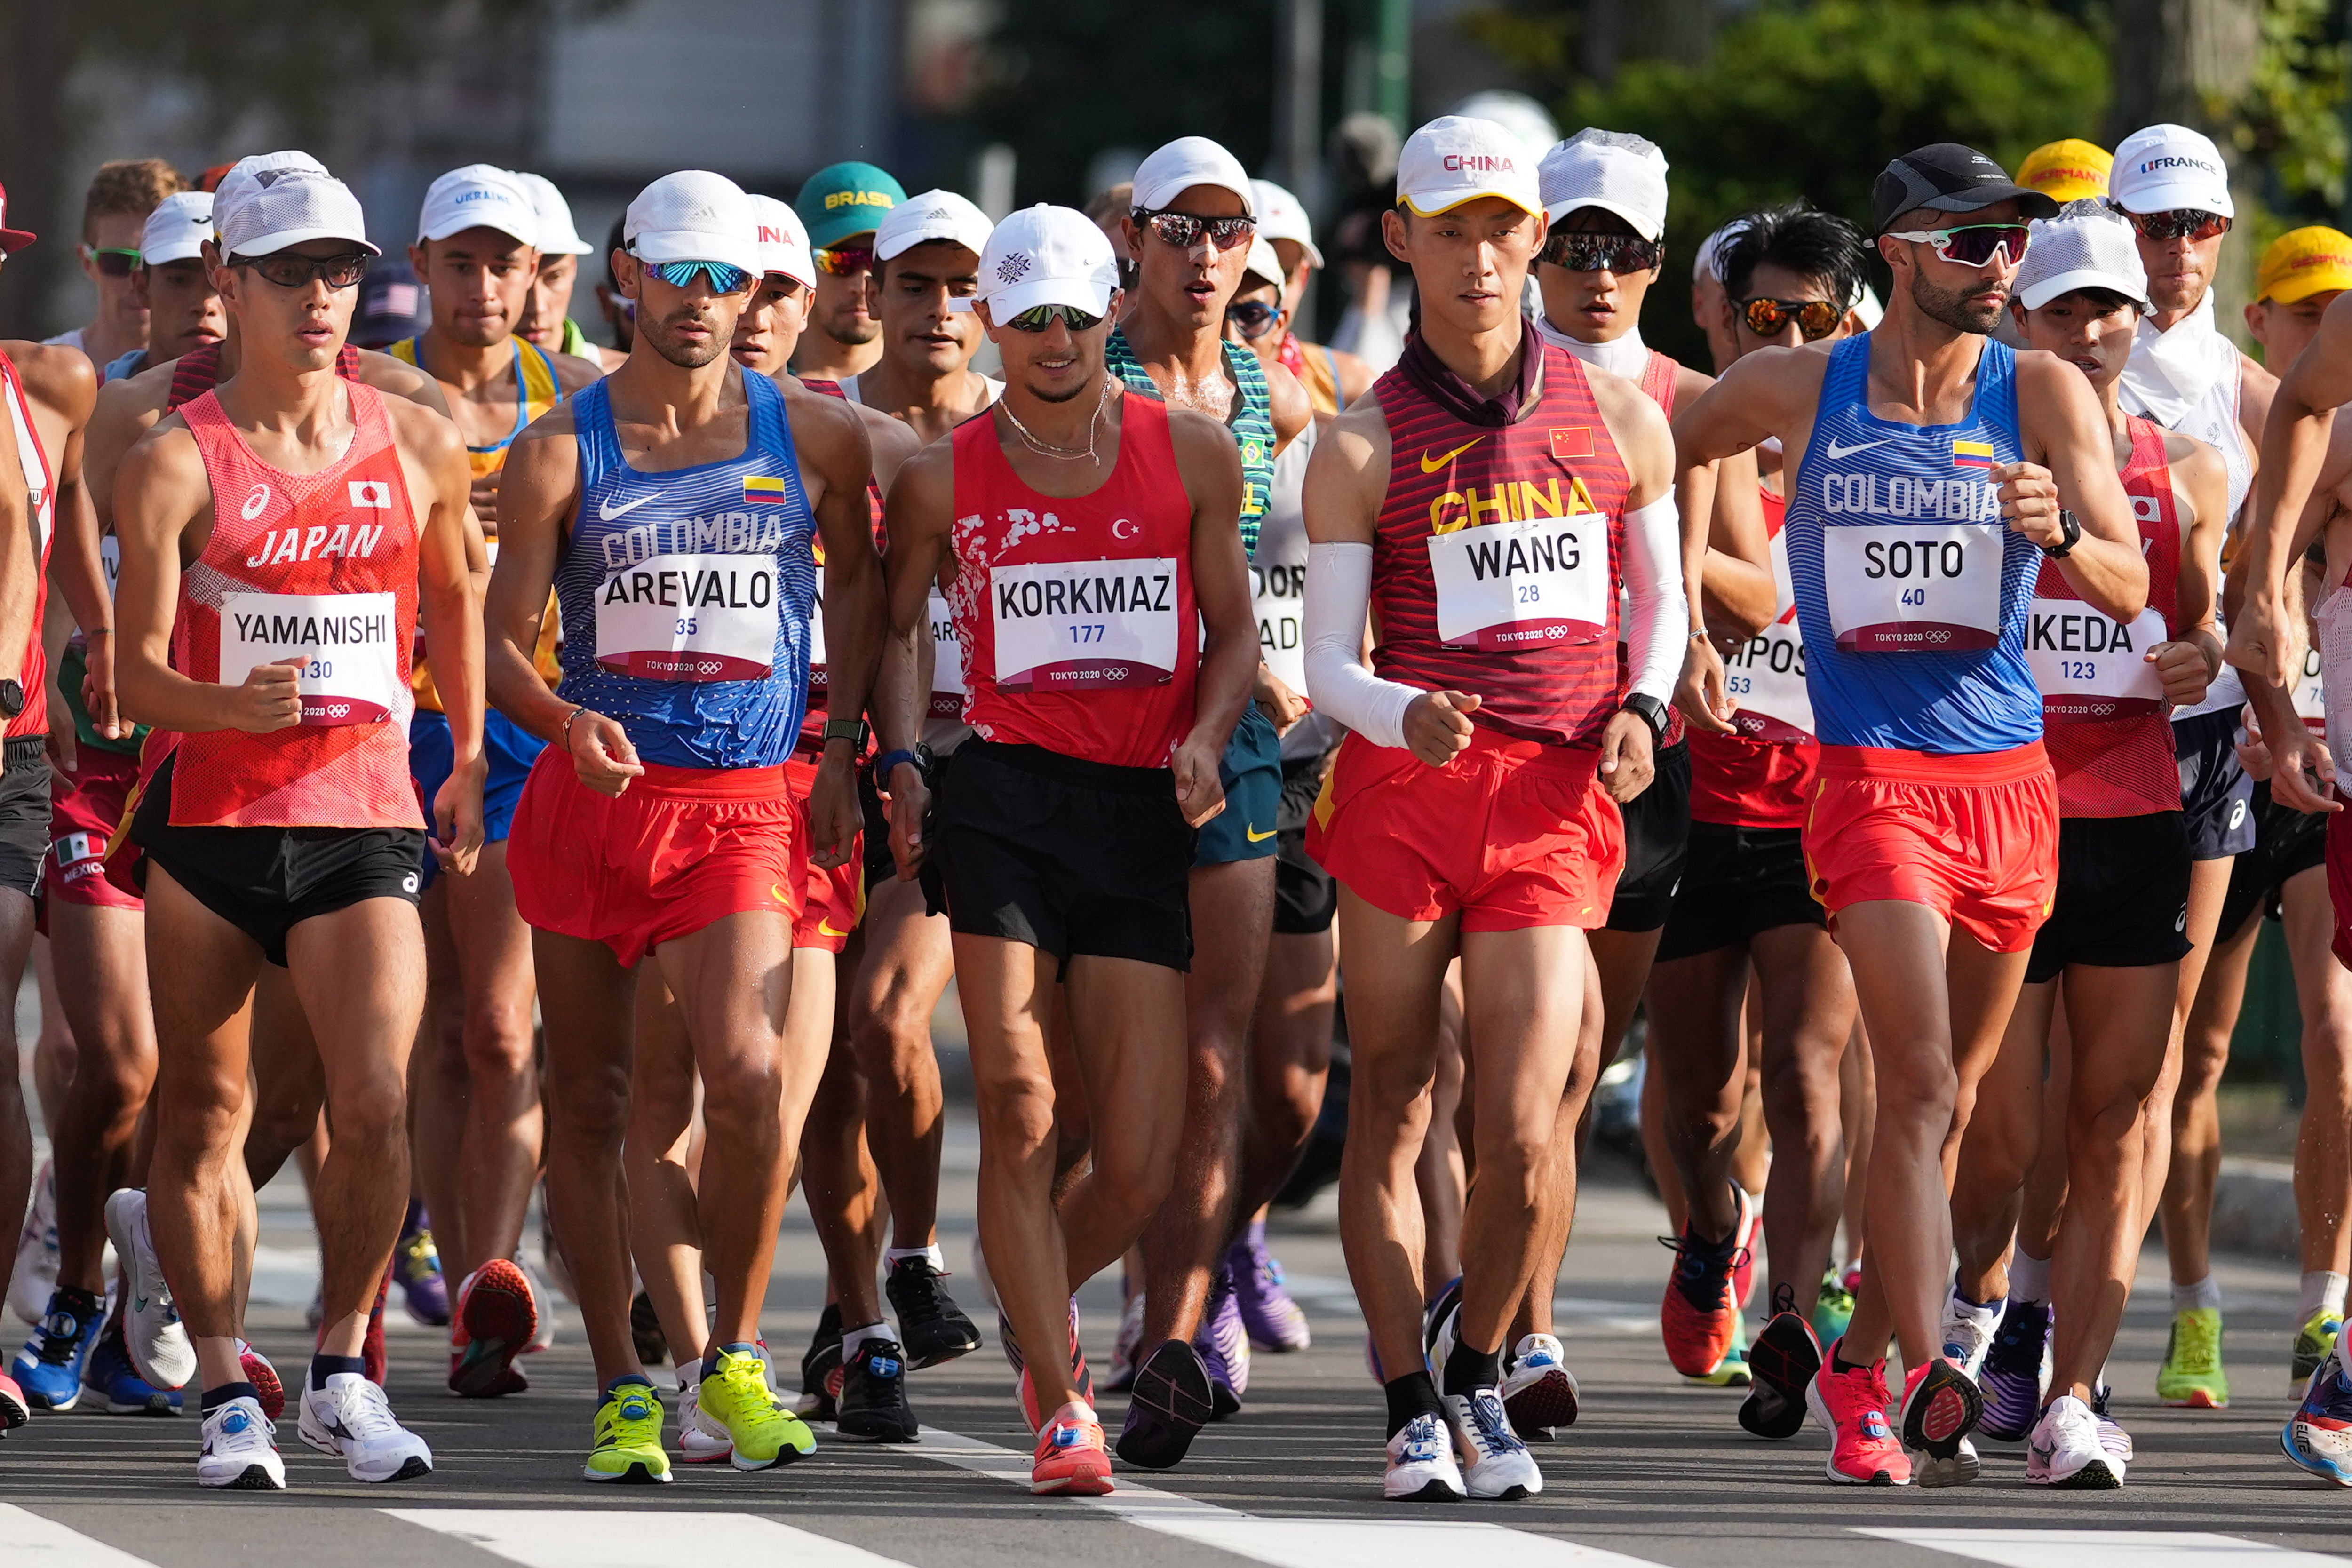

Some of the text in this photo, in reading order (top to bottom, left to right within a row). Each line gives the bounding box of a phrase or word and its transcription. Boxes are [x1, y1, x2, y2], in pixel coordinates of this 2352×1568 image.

[1443, 154, 1516, 174] CHINA
[2154, 157, 2217, 175] FRANCE
[2029, 167, 2105, 186] GERMANY
[454, 189, 513, 205] UKRAINE
[824, 190, 896, 210] BRASIL
[1429, 476, 1598, 535] CHINA
[1823, 472, 2001, 523] COLOMBIA
[246, 523, 385, 568] JAPAN
[601, 511, 783, 568] COLOMBIA
[1465, 533, 1580, 581] WANG
[1864, 541, 1963, 579] SOTO
[604, 570, 771, 609] AREVALO
[999, 575, 1171, 620] KORKMAZ
[1518, 584, 1540, 603] 28
[1901, 588, 1925, 606] 40
[234, 613, 387, 645] YAMANISHI
[675, 617, 698, 636] 35
[1068, 624, 1106, 644] 177
[1496, 631, 1543, 643] TOKYO 2020
[1875, 633, 1923, 643] TOKYO 2020
[645, 660, 694, 672] TOKYO 2020
[1049, 669, 1100, 682] TOKYO 2020
[2060, 661, 2096, 680] 123
[304, 706, 326, 717] 2020
[2067, 706, 2089, 714] 2020
[2296, 1424, 2312, 1454] ELITE
